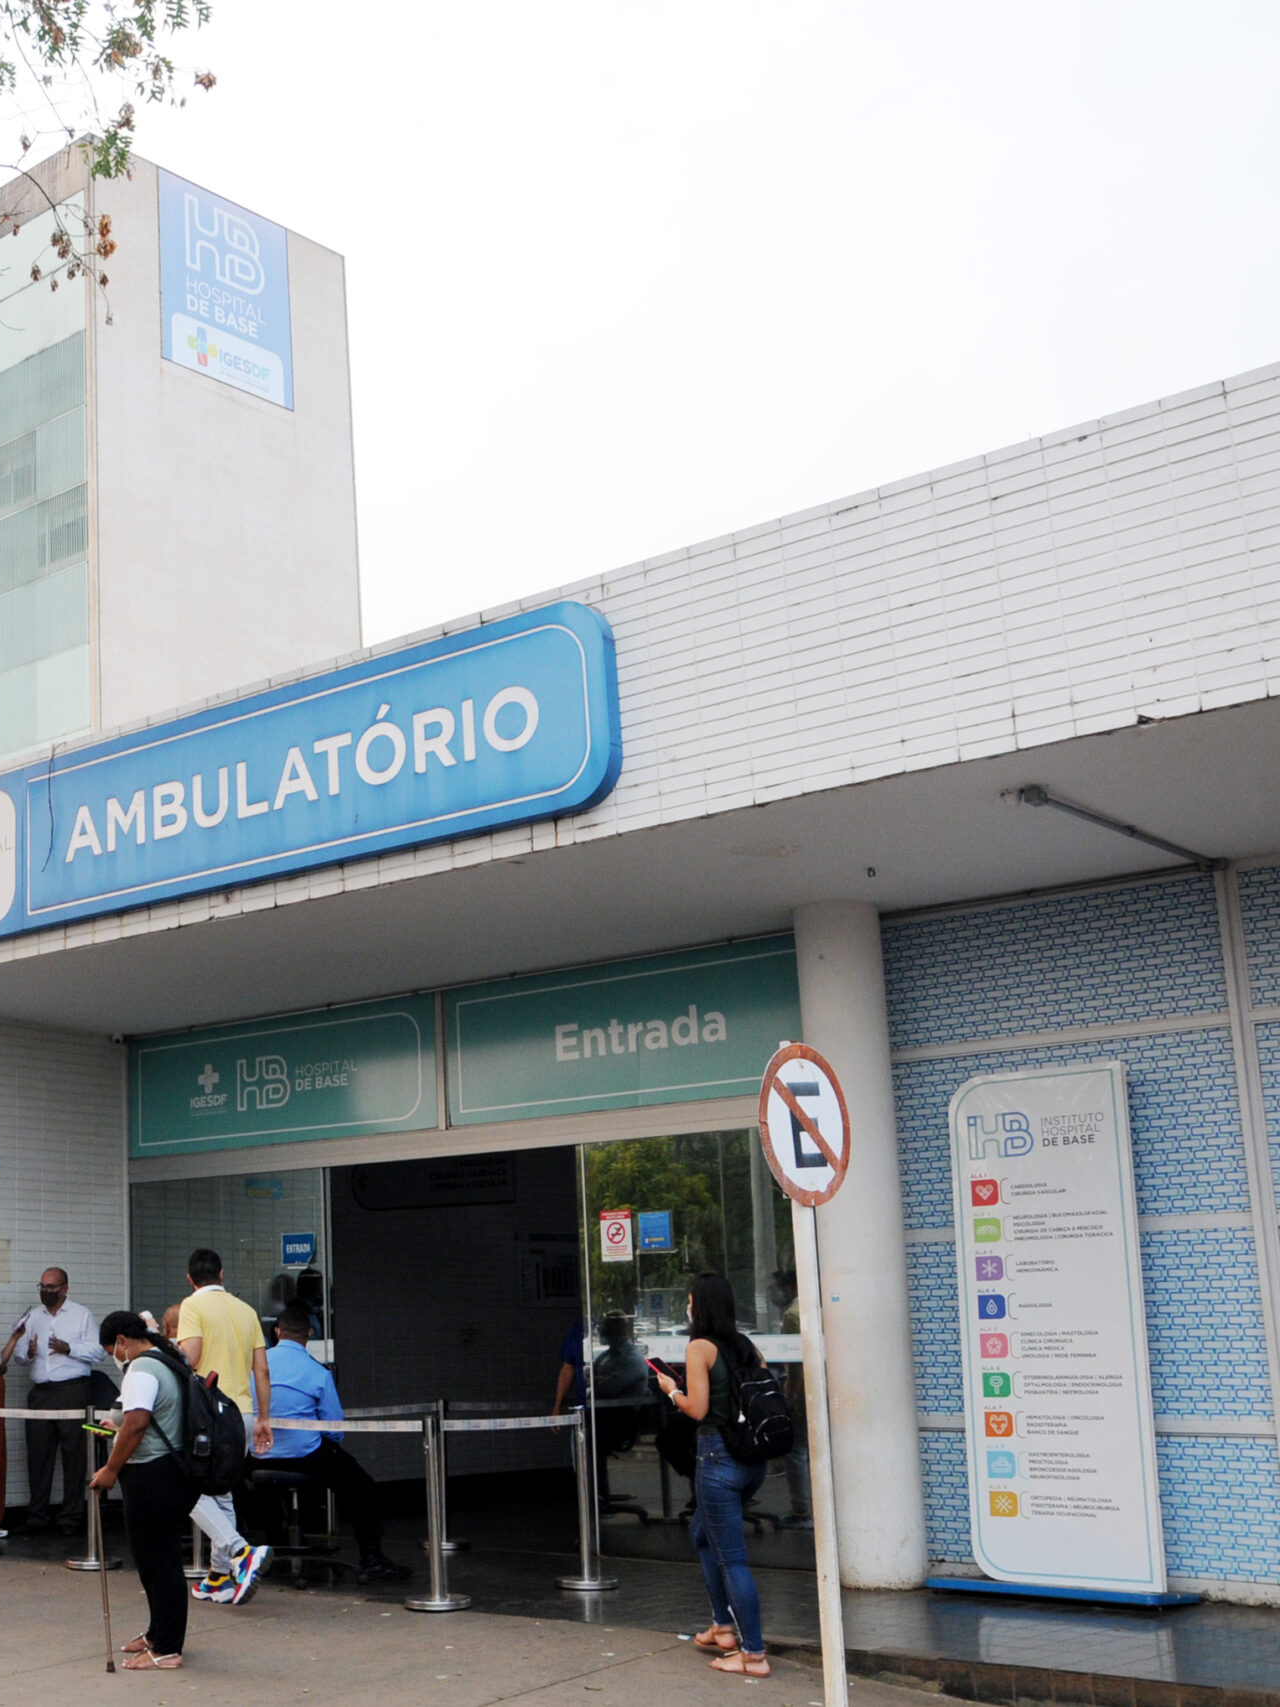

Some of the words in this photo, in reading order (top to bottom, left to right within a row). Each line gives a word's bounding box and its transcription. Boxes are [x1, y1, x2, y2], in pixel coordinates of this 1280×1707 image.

[186, 274, 267, 326] HOSPITAL
[187, 296, 210, 318] DE
[214, 306, 259, 340] BASE
[219, 349, 269, 380] IGESDF
[63, 685, 539, 863] AMBULATÓRIO
[555, 1004, 727, 1062] Entrada
[295, 1059, 358, 1077] HOSPITAL
[295, 1077, 312, 1091] DE
[315, 1073, 348, 1089] BASE
[190, 1093, 228, 1109] IGESDF
[1040, 1112, 1105, 1127] INSTITUTO
[1041, 1123, 1101, 1137] HOSPITAL
[1042, 1137, 1059, 1147] DE
[1062, 1134, 1095, 1146] BASE
[286, 1243, 311, 1254] ENTRADA
